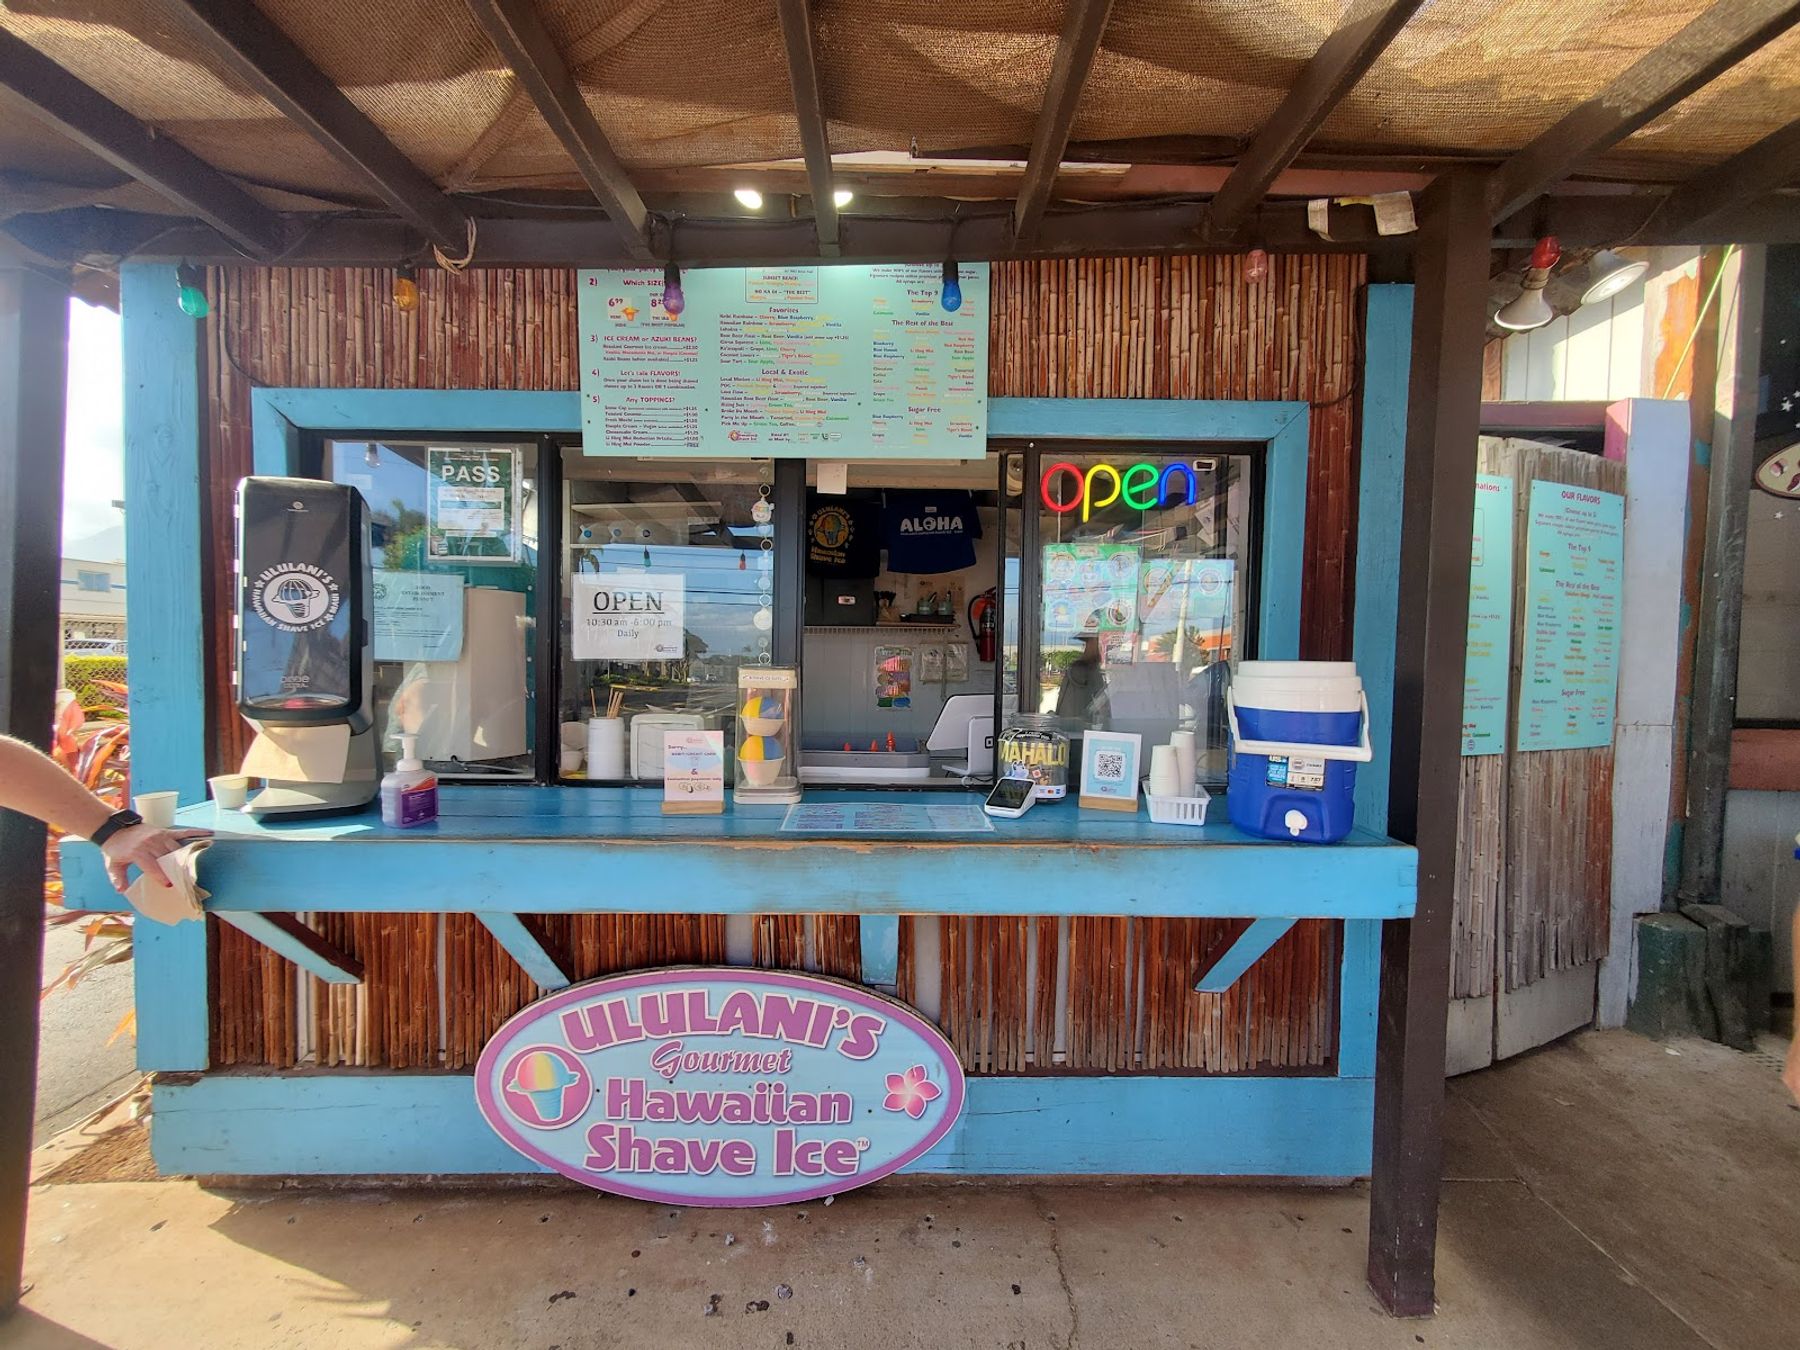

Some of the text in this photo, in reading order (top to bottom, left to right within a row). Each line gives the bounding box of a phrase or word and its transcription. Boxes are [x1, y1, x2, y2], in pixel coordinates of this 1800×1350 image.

[592, 396, 600, 404] 5)
[908, 406, 942, 414] Sugar Free
[442, 465, 500, 482] PASS
[1561, 490, 1600, 504] OUR FLAVORS
[901, 517, 963, 532] ALOHA
[260, 562, 334, 584] ULULANI'S
[594, 592, 664, 610] OPEN
[587, 618, 612, 626] 10:30
[658, 620, 672, 629] pm
[618, 630, 639, 639] Daily
[1562, 689, 1574, 697] Sugar
[561, 989, 887, 1060] ULULANI'S
[651, 1040, 793, 1078] Gourmet
[605, 1078, 853, 1125] Hawaiian
[584, 1122, 757, 1175] Shave
